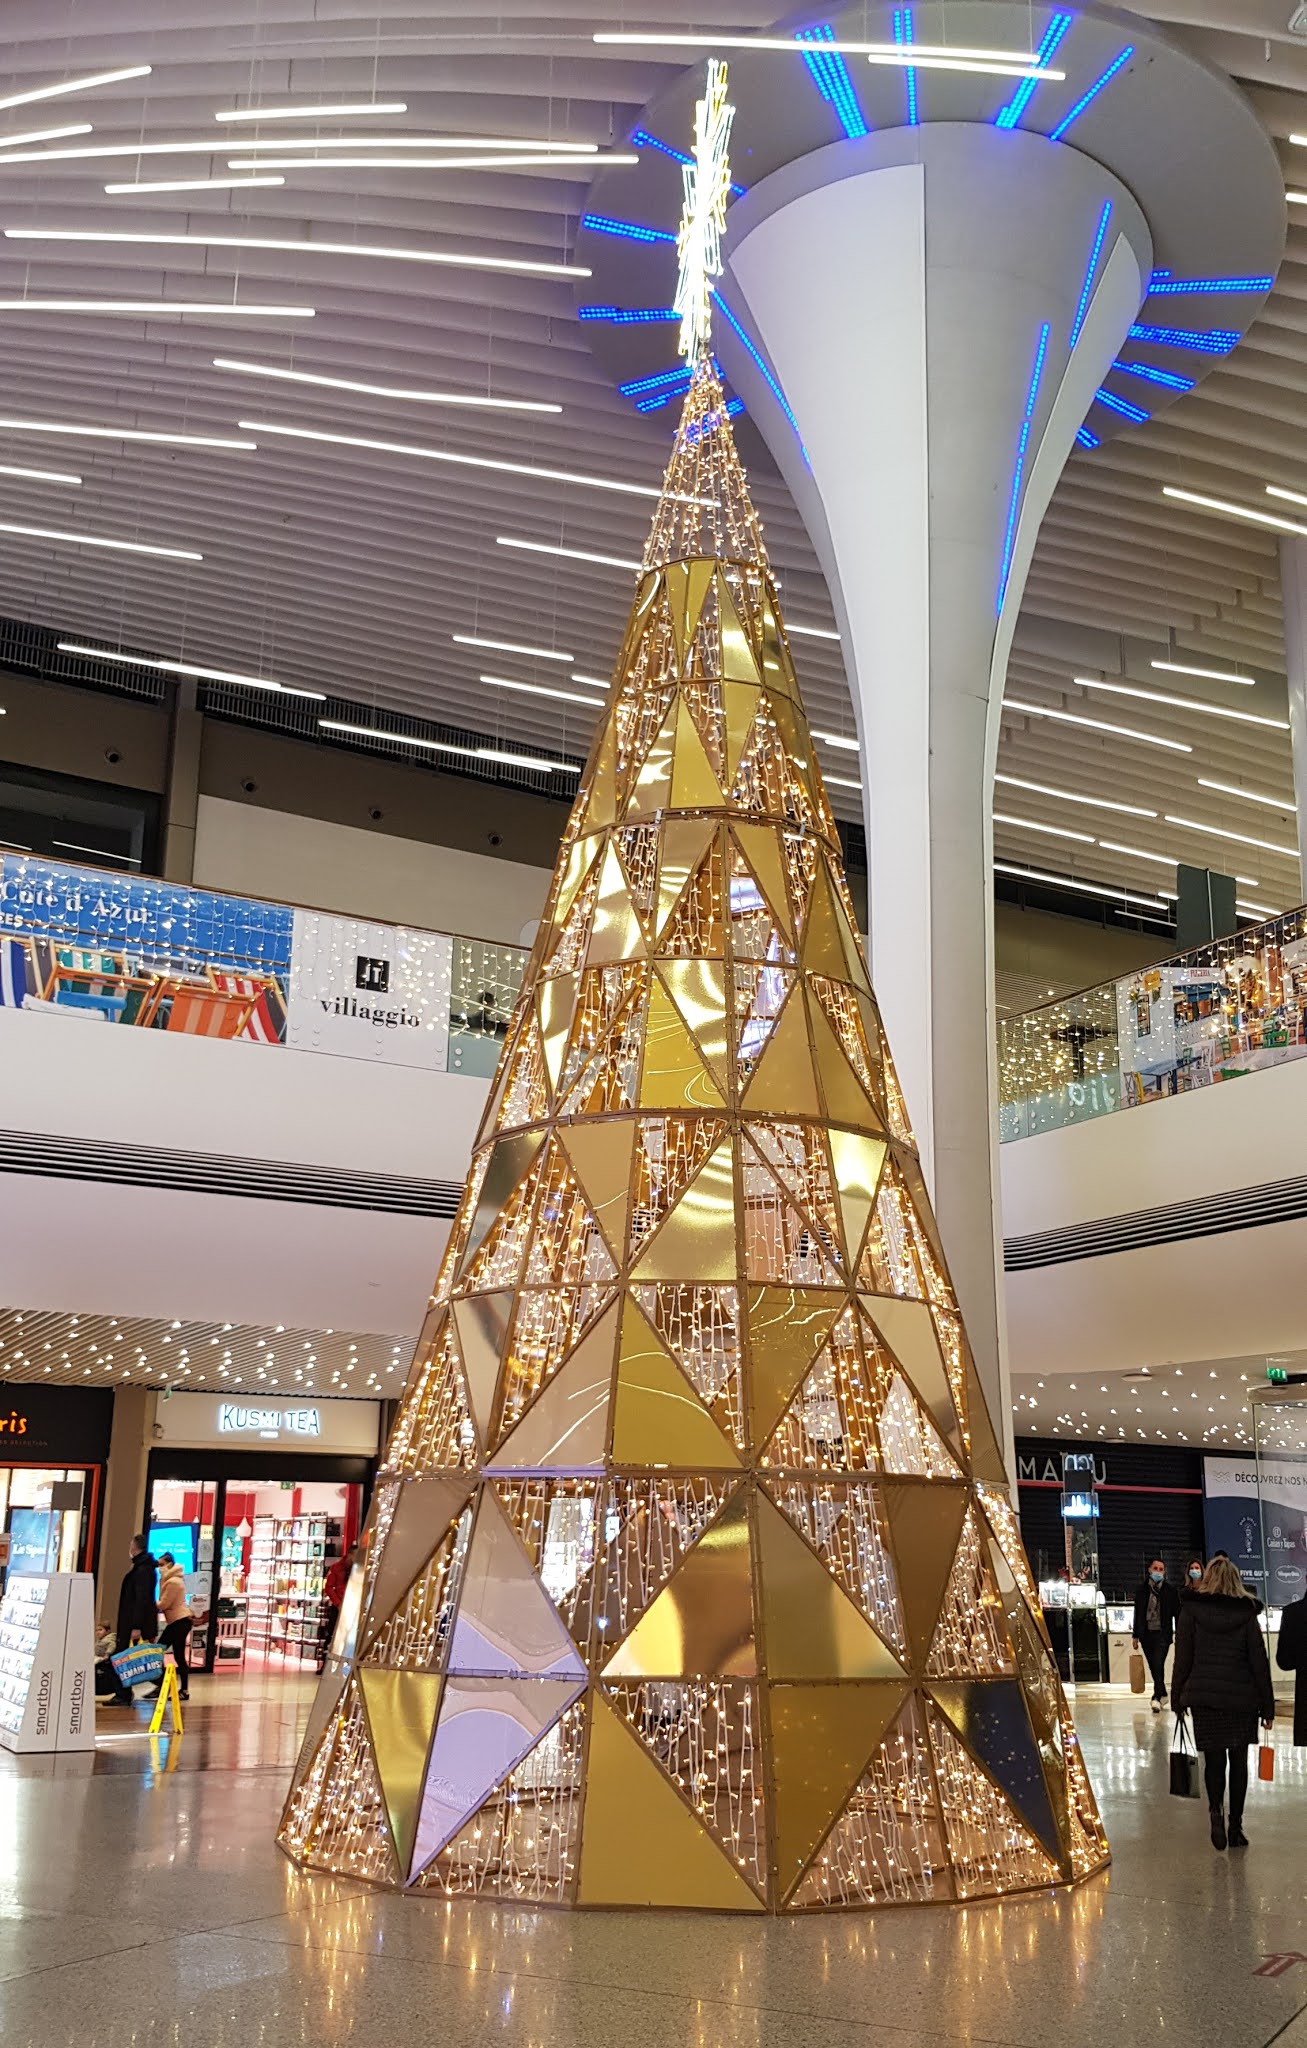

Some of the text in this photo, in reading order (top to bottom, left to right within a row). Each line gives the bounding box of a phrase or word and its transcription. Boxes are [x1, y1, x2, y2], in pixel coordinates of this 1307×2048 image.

[2, 880, 59, 908] Côte
[320, 996, 420, 1029] villaggio
[221, 1403, 320, 1435] KUSMI TEA
[36, 1670, 51, 1736] smartbox
[69, 1670, 84, 1735] smartbox
